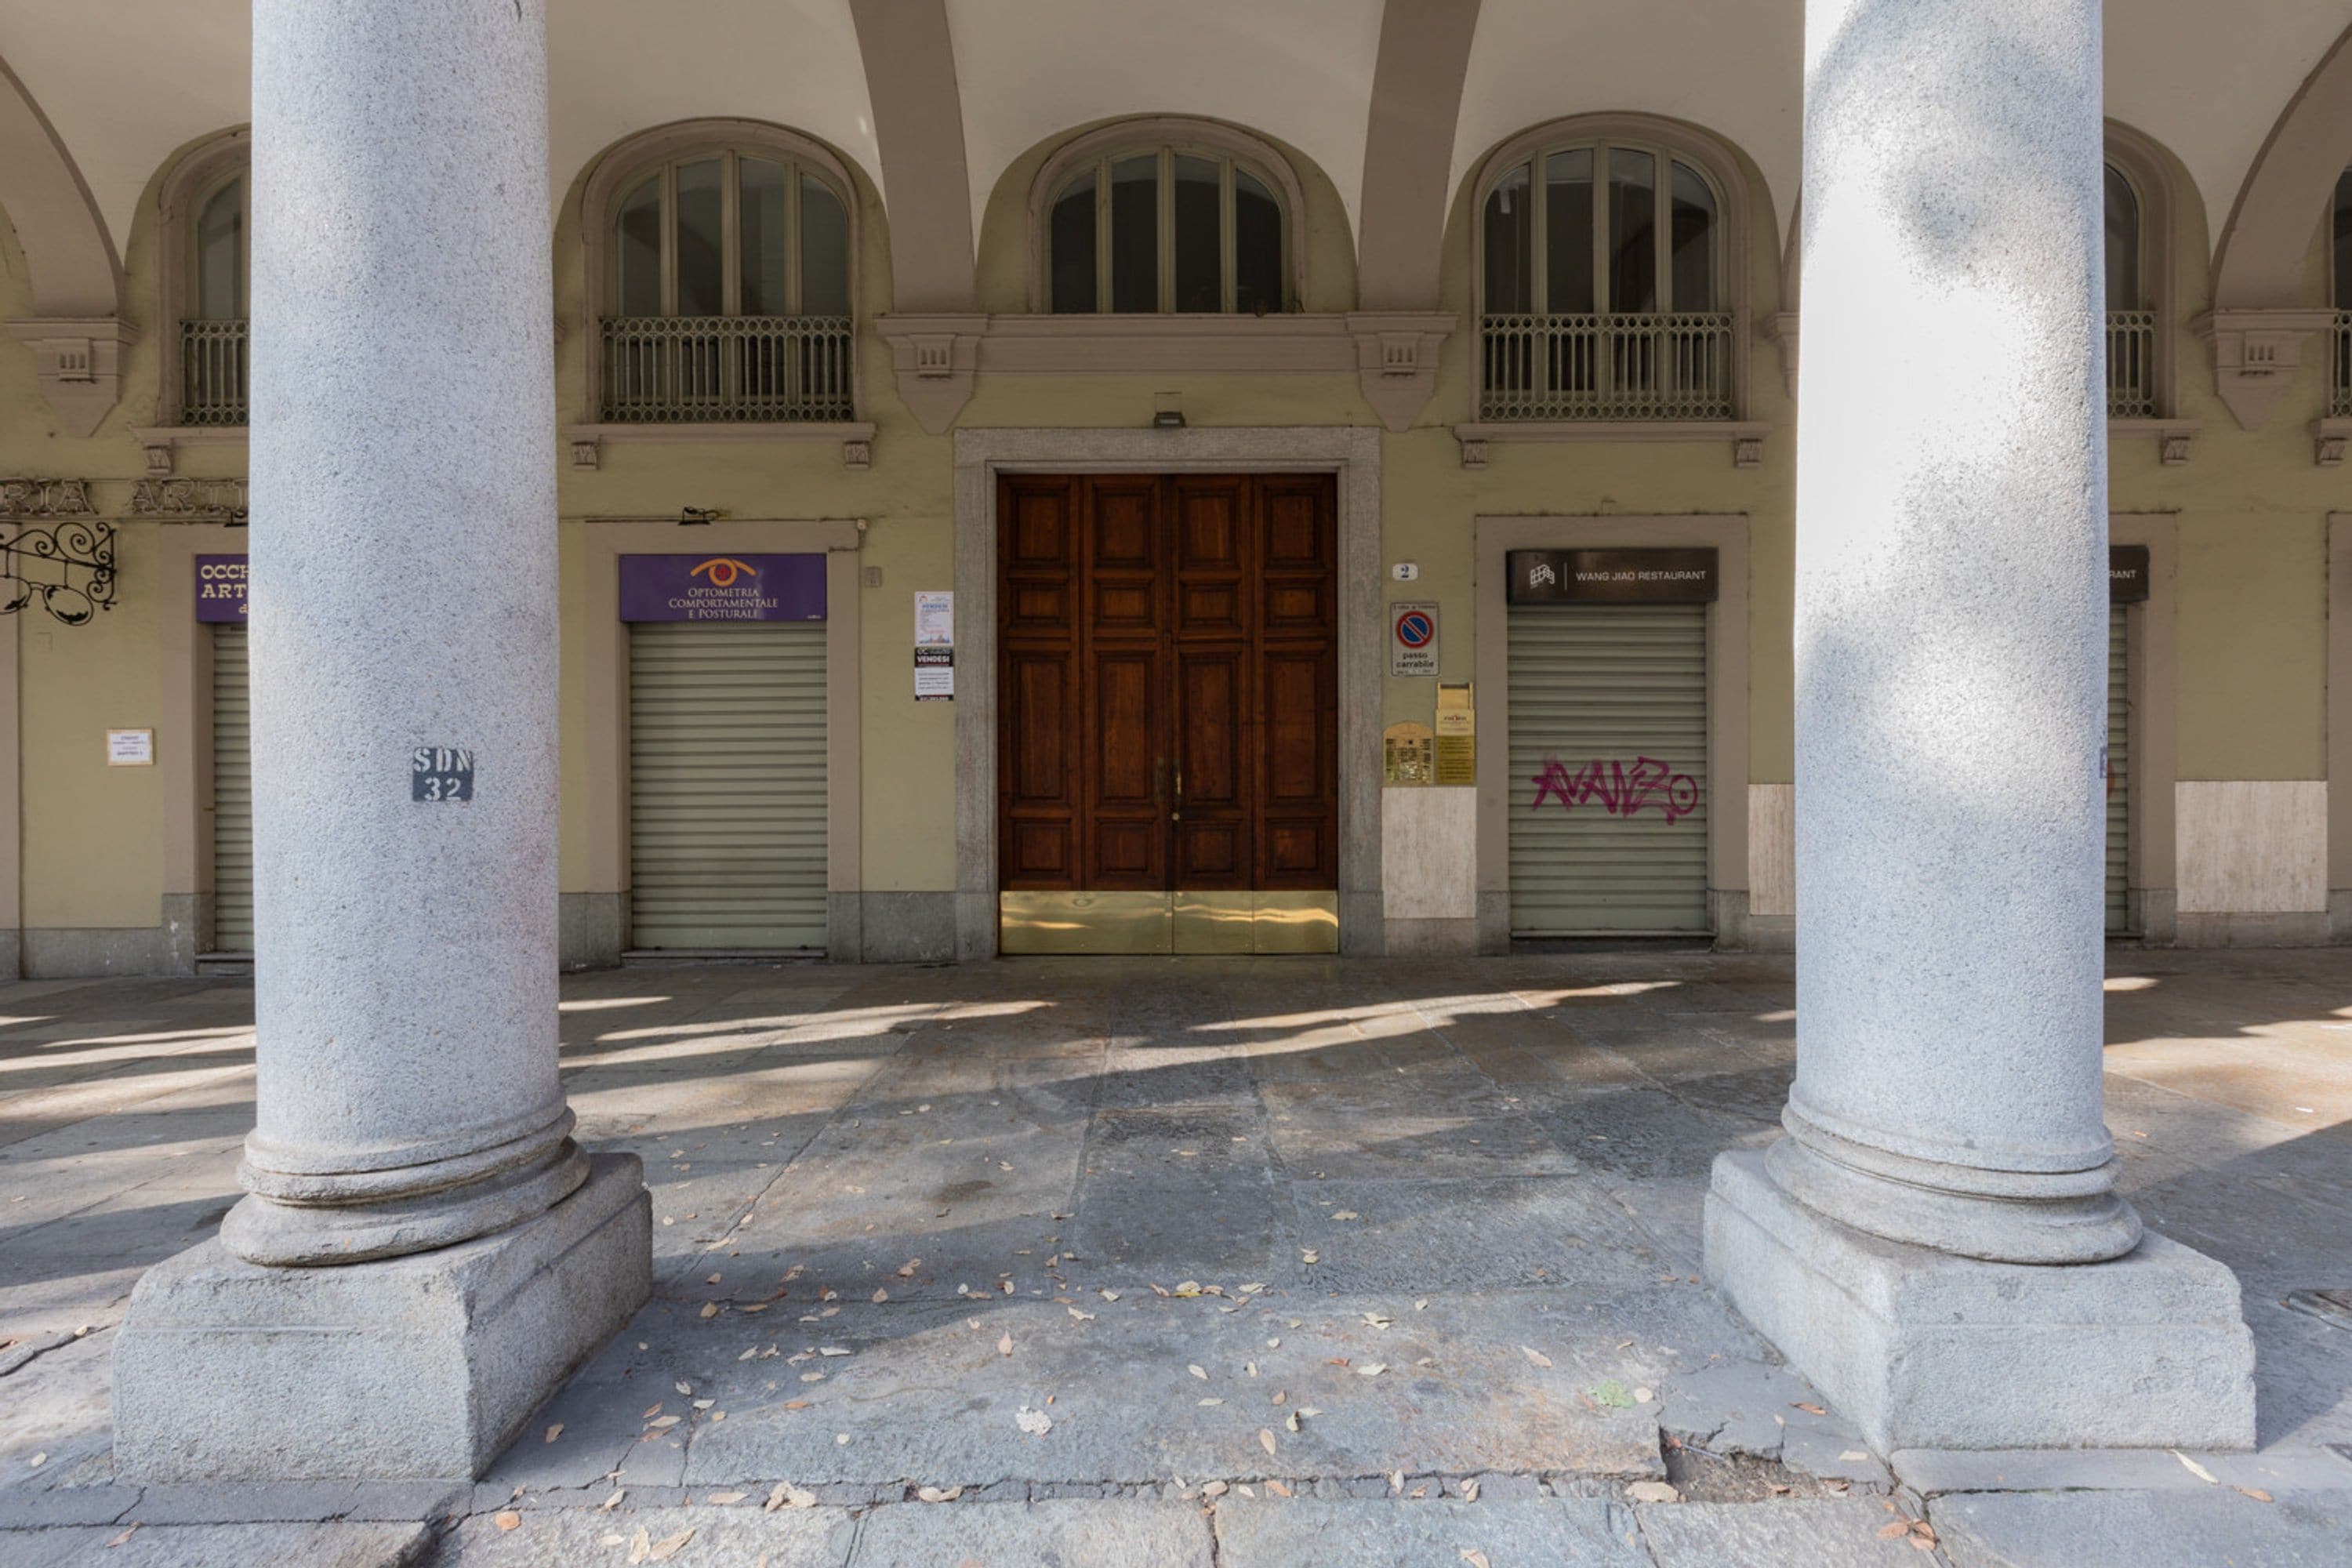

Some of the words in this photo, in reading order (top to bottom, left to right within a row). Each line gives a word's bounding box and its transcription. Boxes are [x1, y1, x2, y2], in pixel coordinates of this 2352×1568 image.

[1401, 564, 1410, 579] 2
[1576, 571, 1610, 582] WANG
[1612, 571, 1635, 581] JIAO
[1638, 570, 1707, 581] RESTAURANT
[201, 583, 247, 598] ART
[688, 588, 760, 597] OPTOMETRIA
[669, 598, 779, 608] COMPORTAMENTALE
[688, 609, 694, 619] E
[699, 609, 760, 619] POSTURALE
[413, 748, 472, 773] SDN
[424, 777, 461, 800] 32
